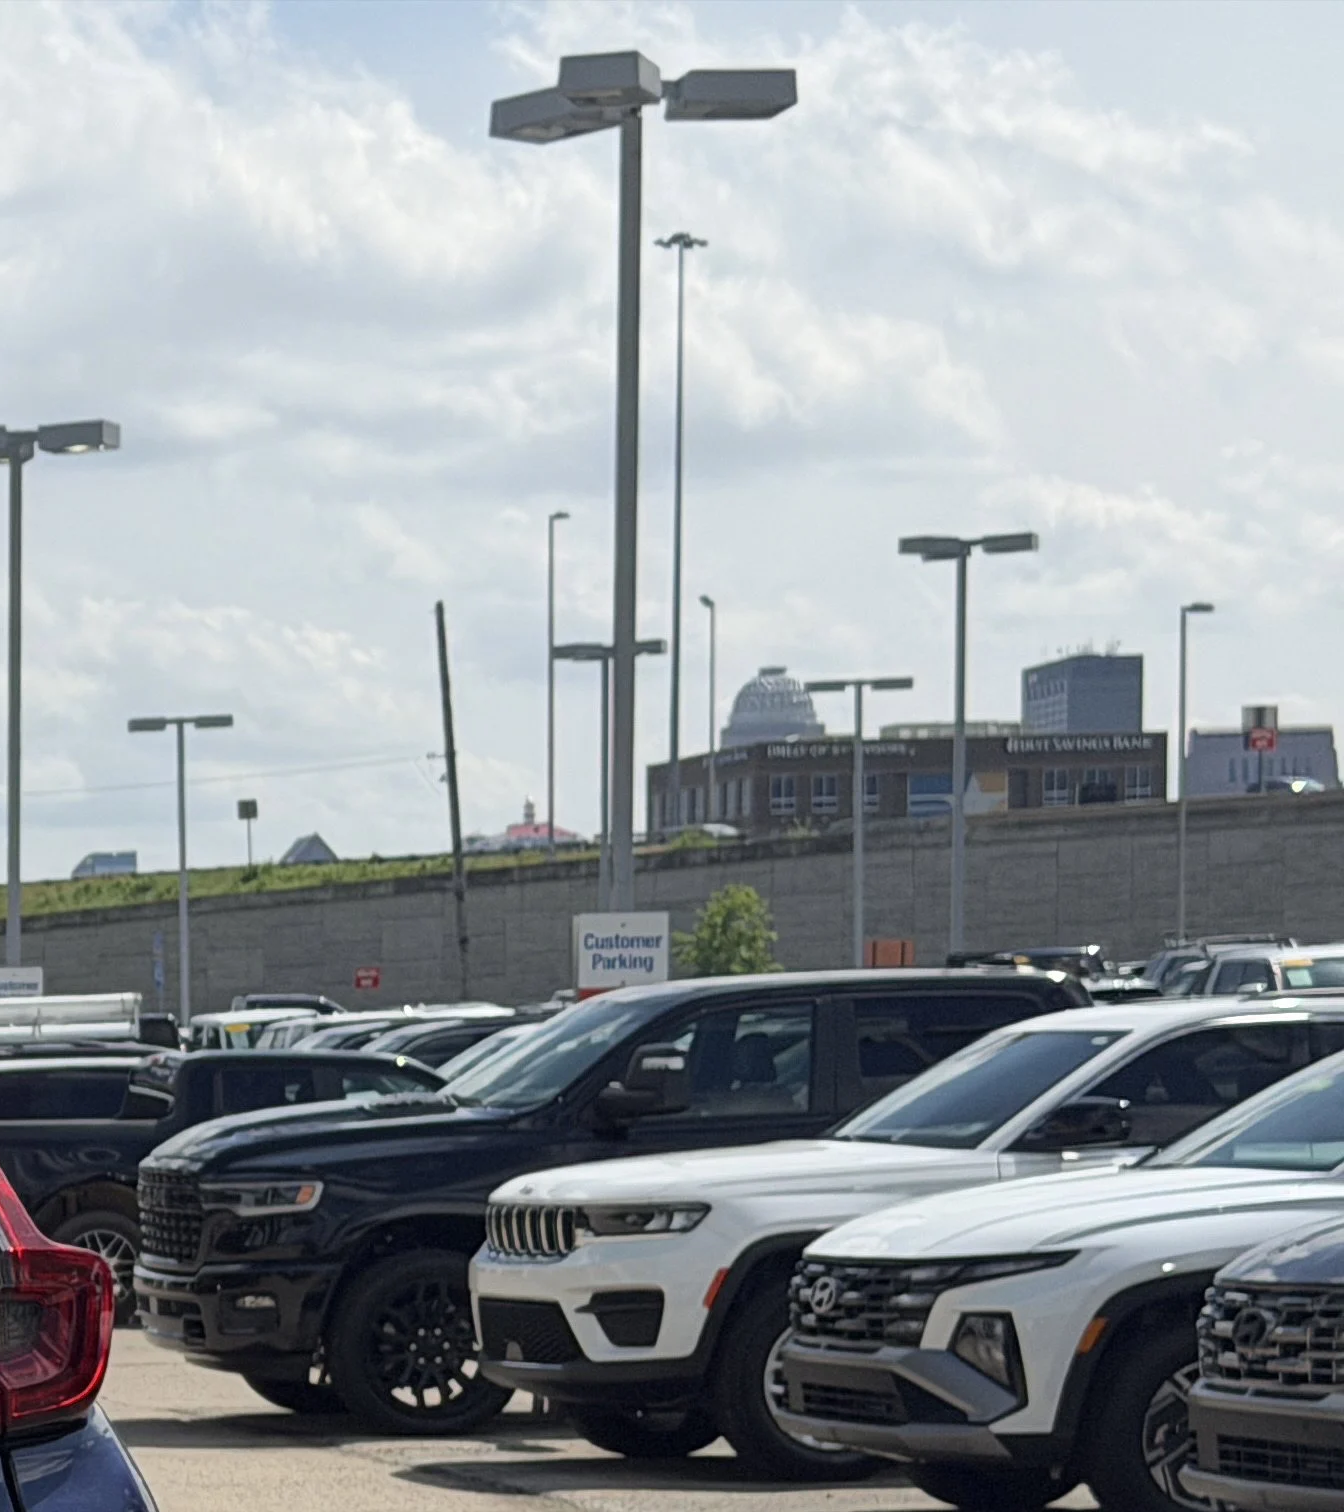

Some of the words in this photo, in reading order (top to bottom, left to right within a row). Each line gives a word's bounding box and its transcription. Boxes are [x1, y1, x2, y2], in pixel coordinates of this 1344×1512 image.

[1113, 735, 1153, 749] BANK
[584, 933, 663, 950] Customer
[592, 953, 654, 973] Parking
